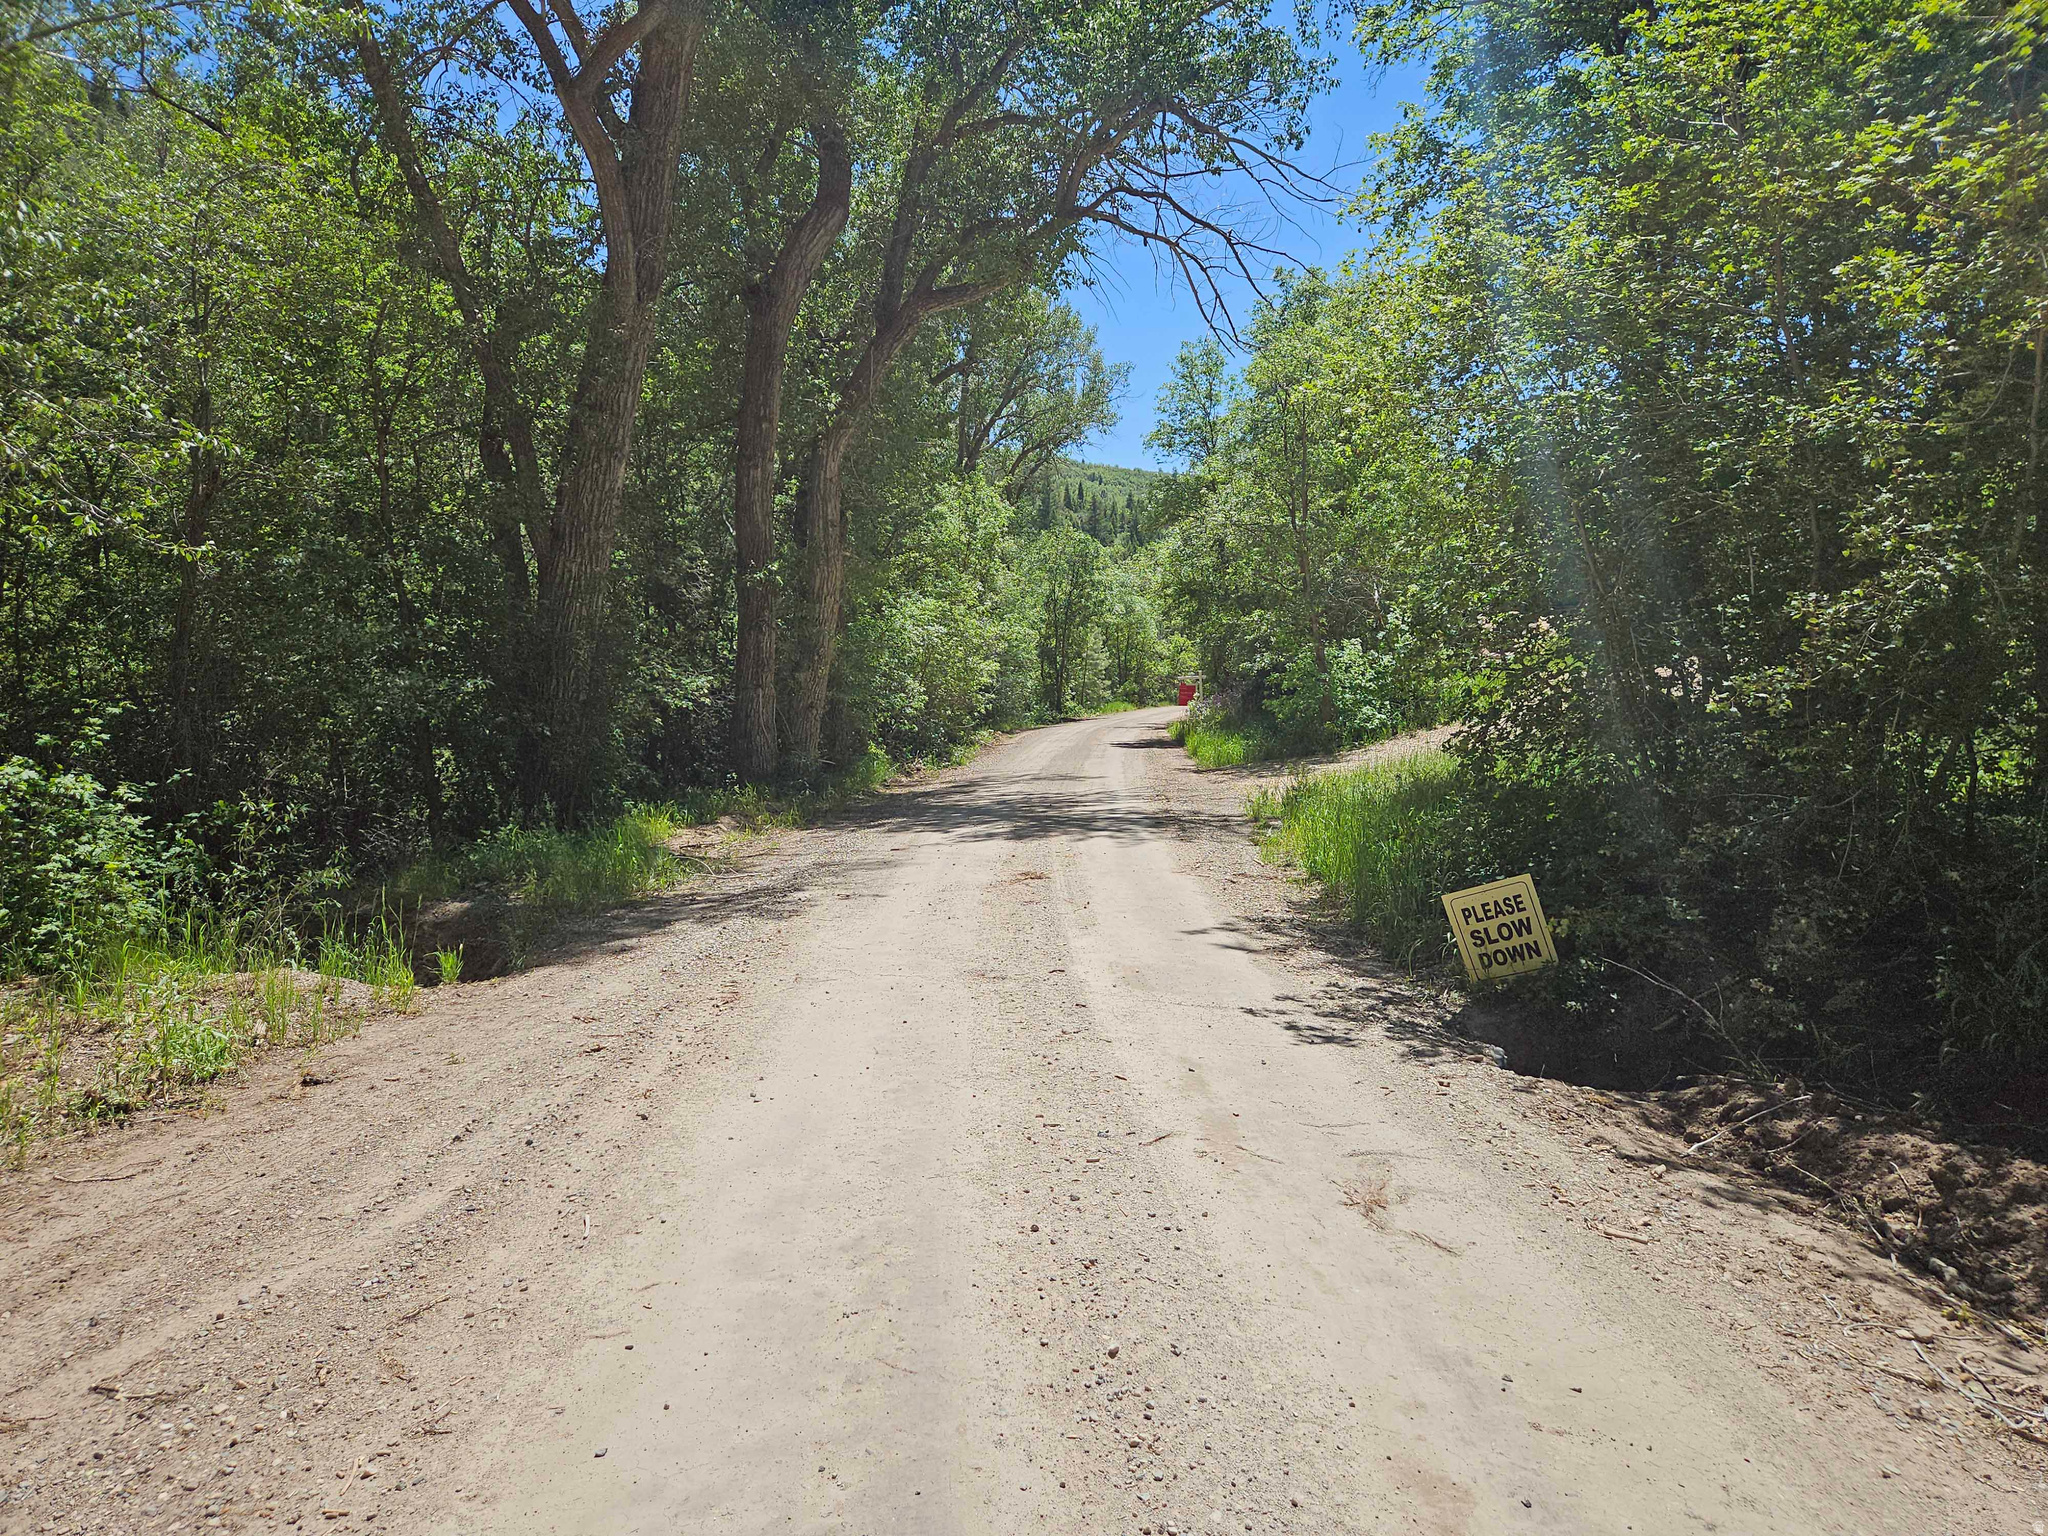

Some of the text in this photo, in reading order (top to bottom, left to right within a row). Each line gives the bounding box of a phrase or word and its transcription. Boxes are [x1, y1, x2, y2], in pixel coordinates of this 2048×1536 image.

[1461, 894, 1527, 925] PLEASE
[1470, 917, 1533, 947] SLOW
[1478, 940, 1542, 970] DOWN
